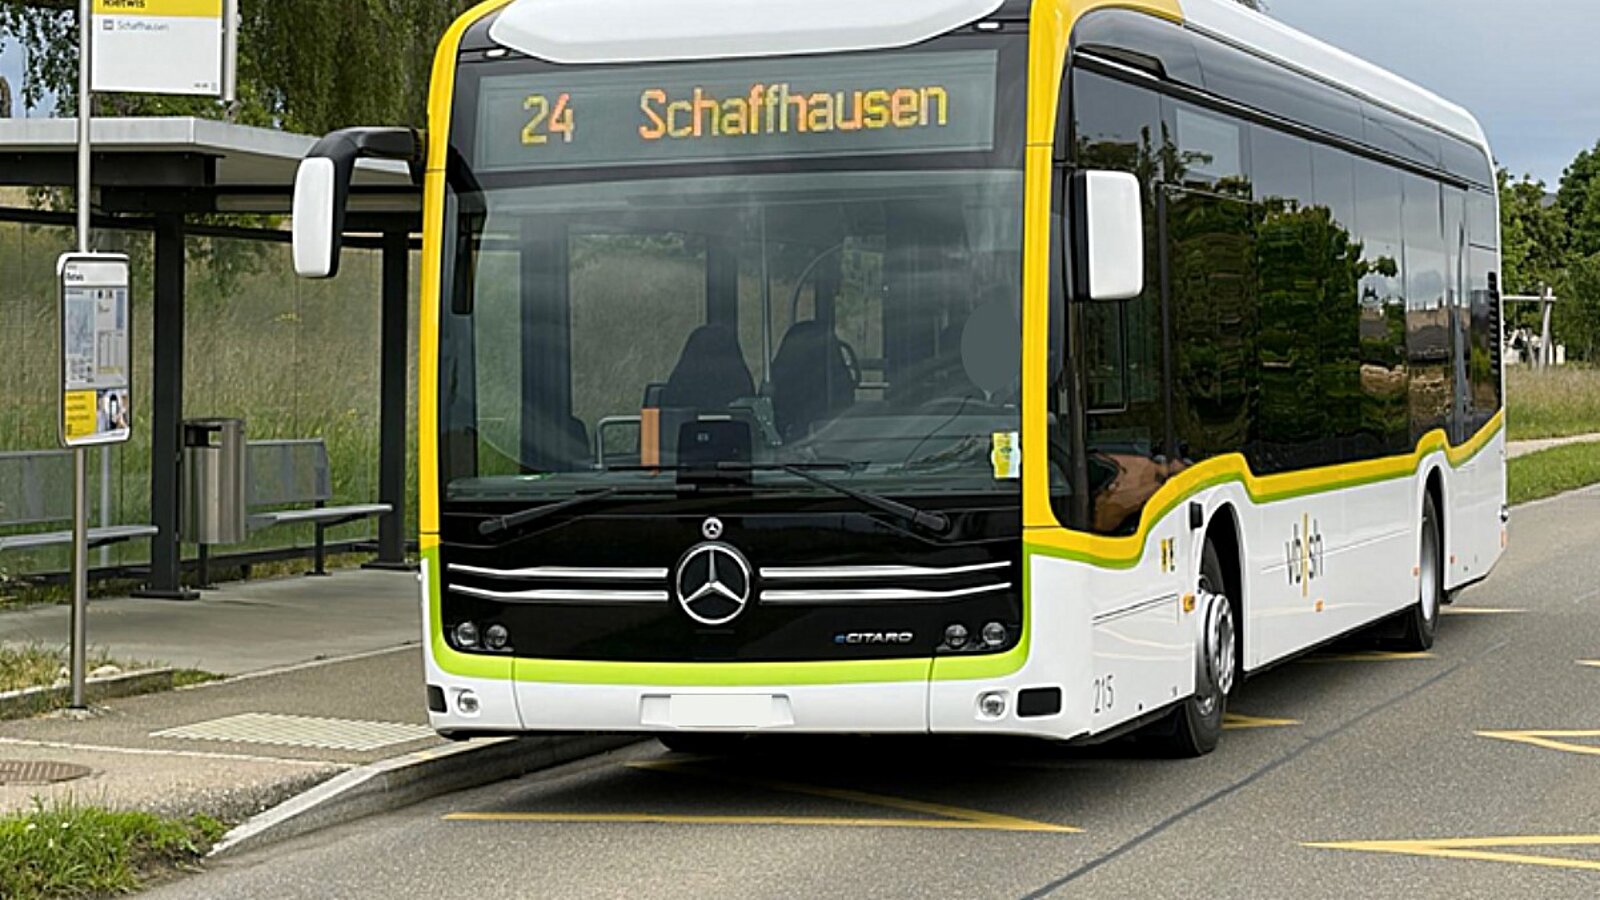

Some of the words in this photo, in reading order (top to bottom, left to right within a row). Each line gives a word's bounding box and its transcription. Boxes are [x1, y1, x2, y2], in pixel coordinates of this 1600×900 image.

[521, 94, 574, 144] 24
[638, 84, 948, 139] Schaffhausen
[835, 632, 913, 643] eCITARO
[1093, 674, 1114, 713] 215
